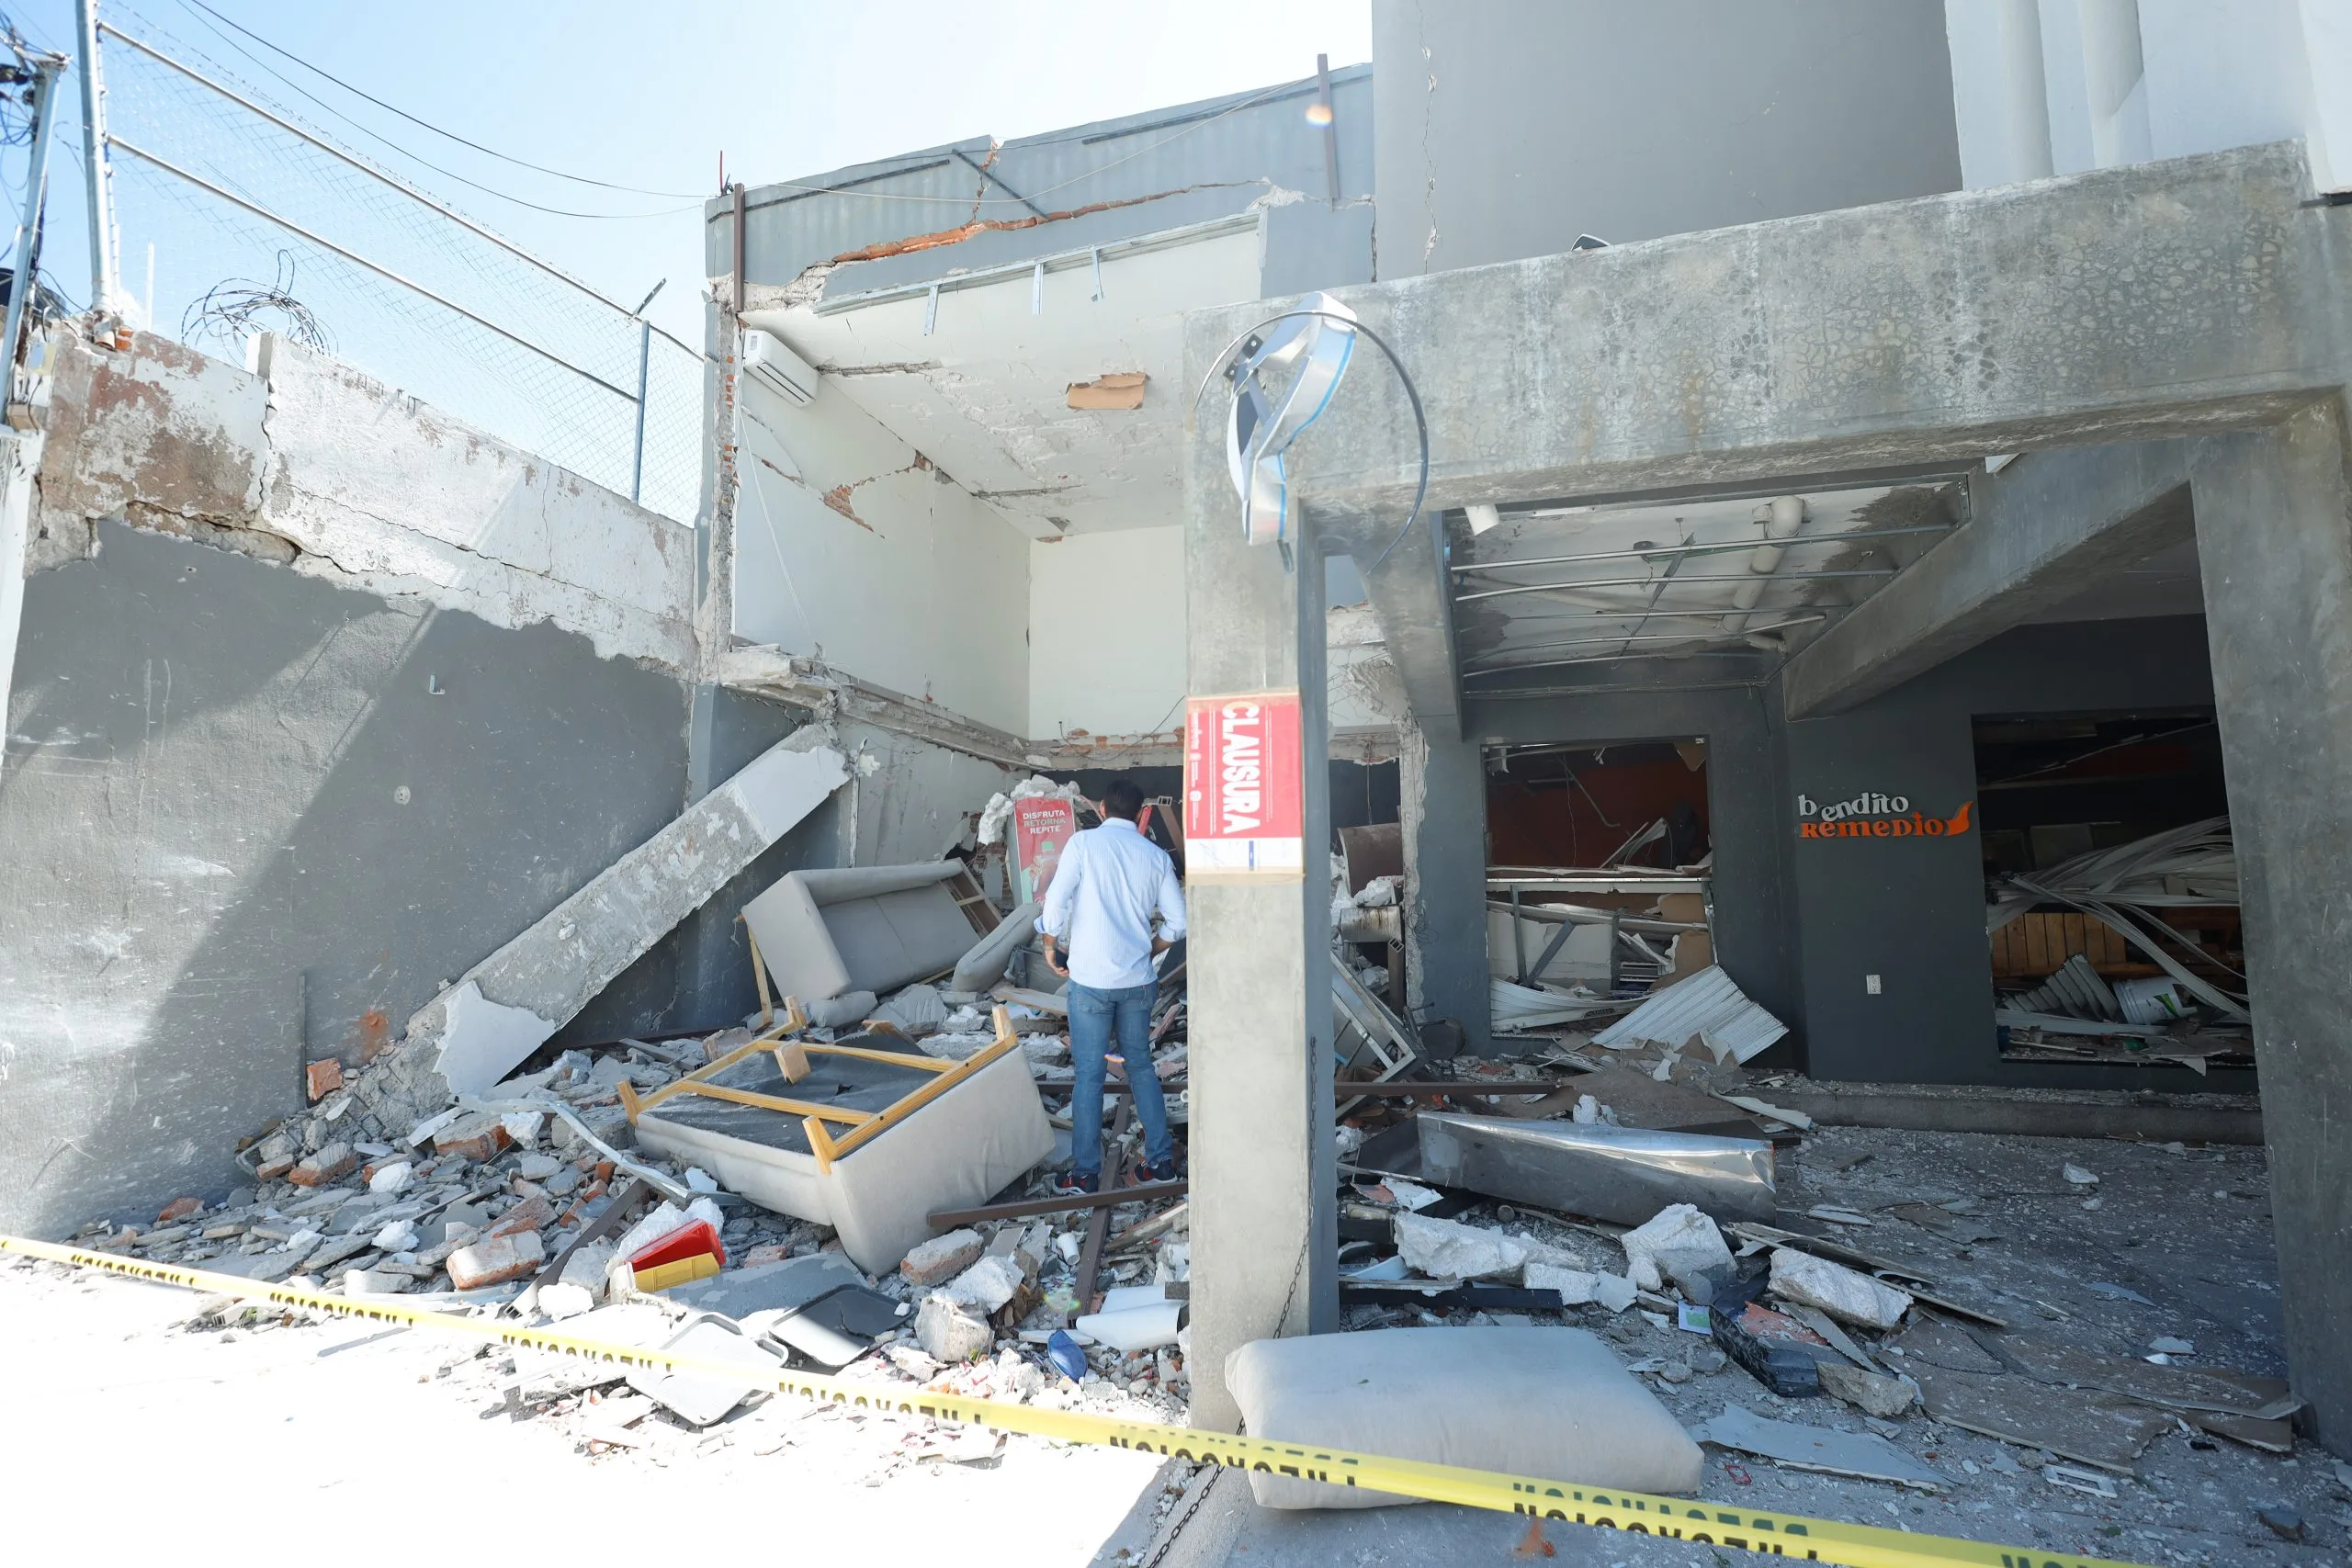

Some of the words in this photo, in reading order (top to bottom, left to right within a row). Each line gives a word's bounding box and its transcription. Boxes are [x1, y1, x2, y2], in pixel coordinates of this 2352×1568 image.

[1222, 701, 1261, 834] CLAUSURA
[1798, 793, 1909, 822] bendito
[1023, 809, 1066, 820] DISFRUTA
[1023, 818, 1066, 828] RETORNA
[1030, 826, 1061, 835] REPITE
